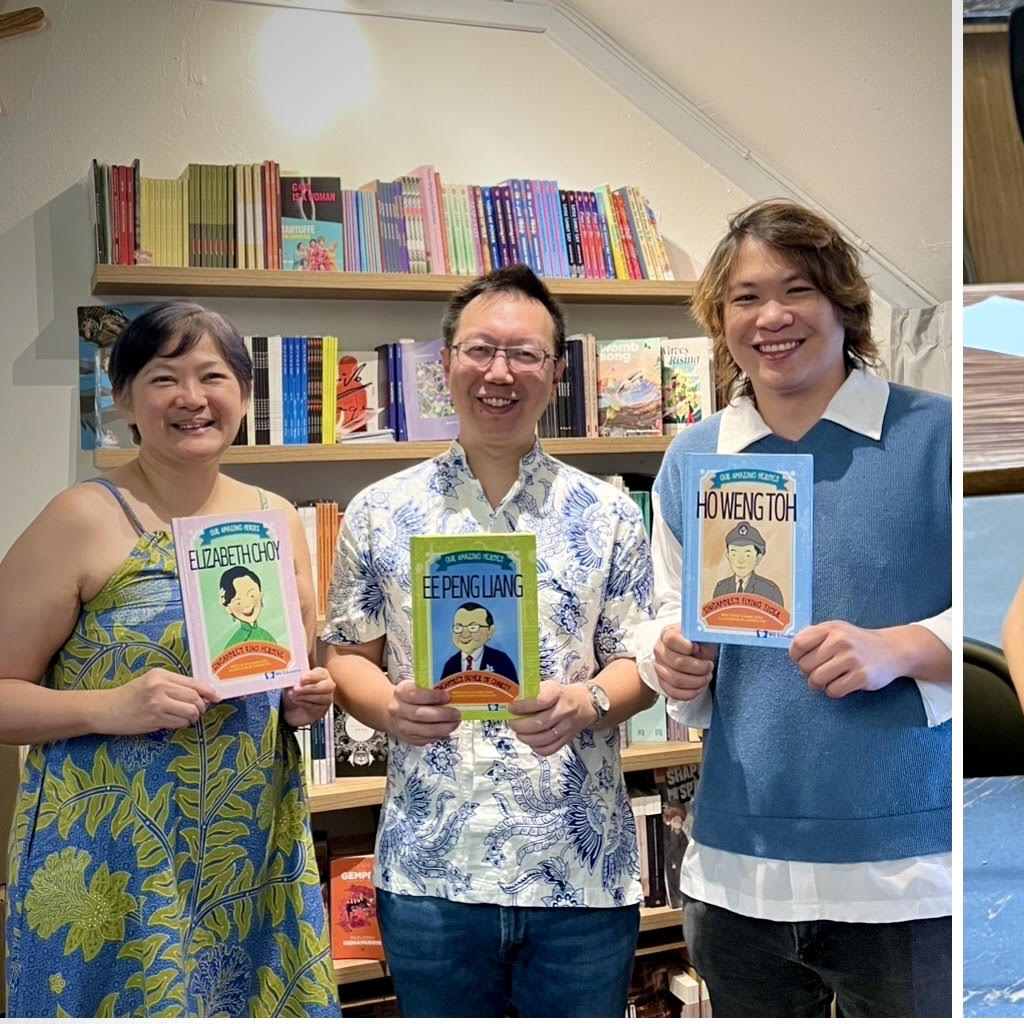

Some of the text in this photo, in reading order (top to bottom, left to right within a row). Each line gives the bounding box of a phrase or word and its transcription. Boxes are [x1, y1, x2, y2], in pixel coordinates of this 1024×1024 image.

[719, 472, 780, 483] OUR AMAZING HEROES
[696, 491, 797, 522] HO WENG TOH
[221, 525, 243, 535] AMAZING
[188, 540, 281, 571] ELIZABETH CHOY
[445, 554, 456, 563] OUR
[457, 553, 481, 561] AMAZING
[423, 574, 524, 599] EE PENG LIANG
[741, 597, 762, 608] FLYING
[666, 764, 697, 785] SHAP
